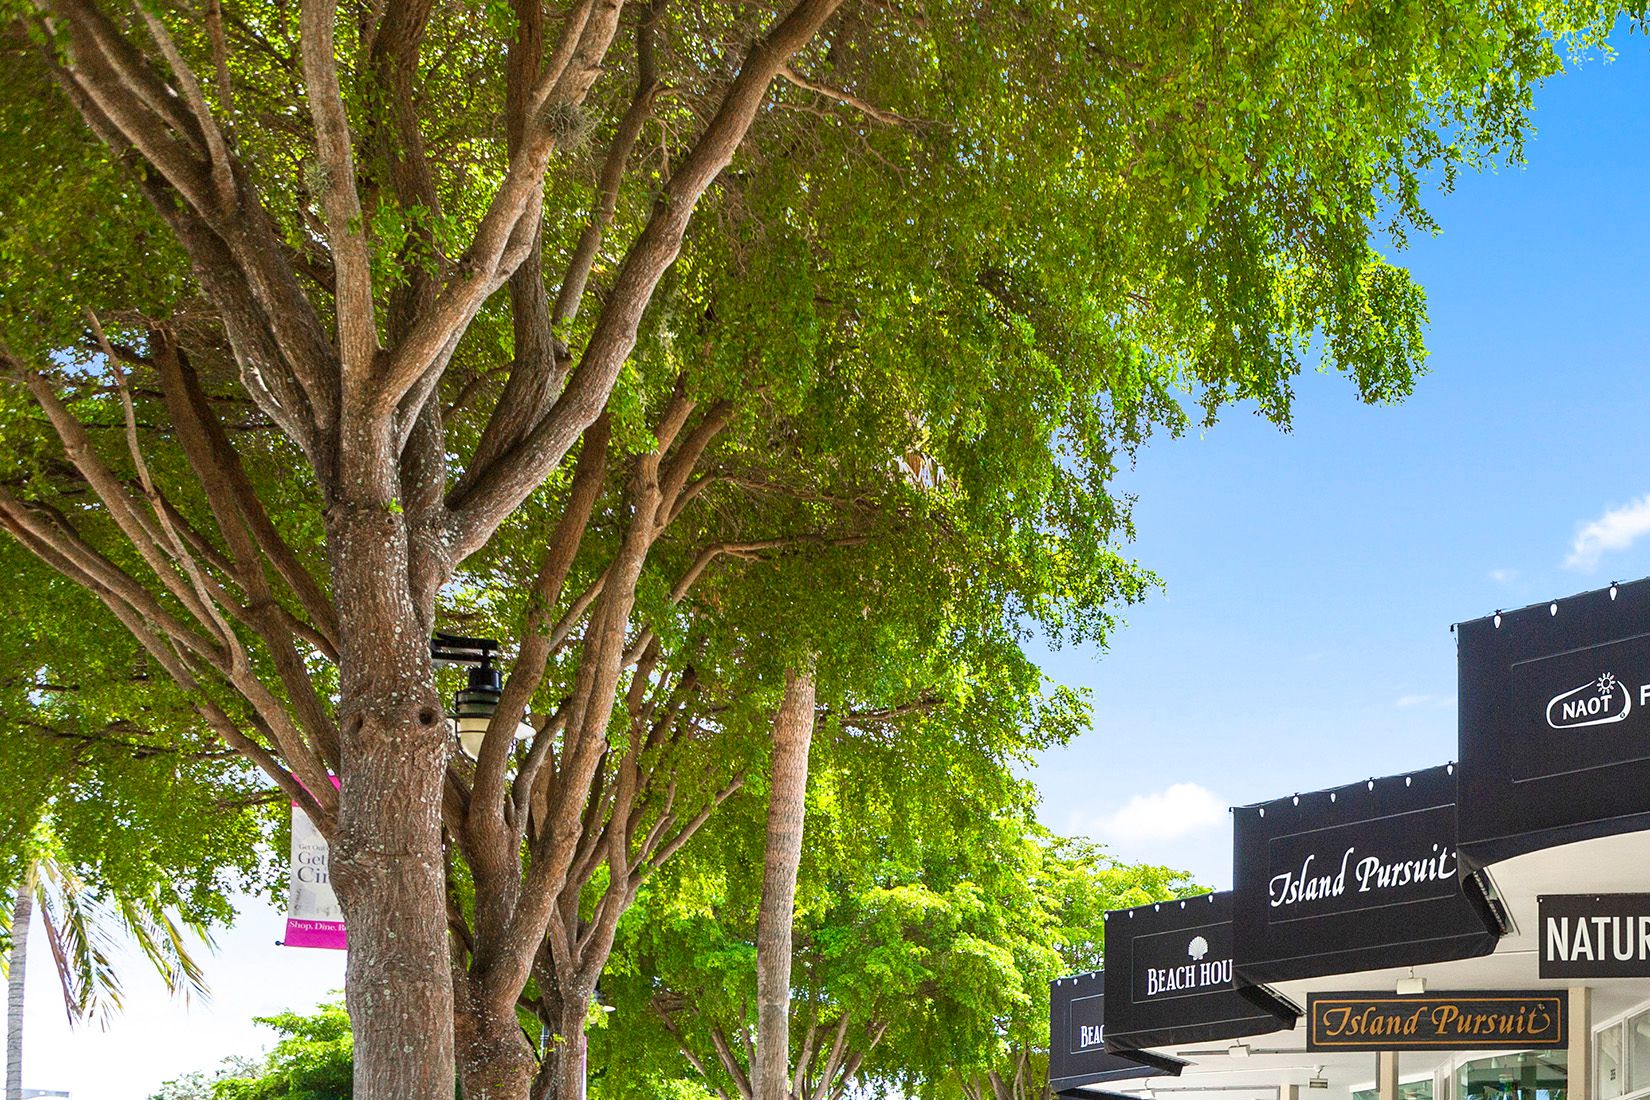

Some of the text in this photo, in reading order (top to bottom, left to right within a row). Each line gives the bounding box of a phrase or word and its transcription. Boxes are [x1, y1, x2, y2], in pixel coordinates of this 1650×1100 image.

[1562, 694, 1614, 720] NAOT
[1269, 843, 1456, 907] Island Pursuit
[1147, 965, 1196, 996] BEACH
[1323, 1003, 1550, 1036] Island Pursuit
